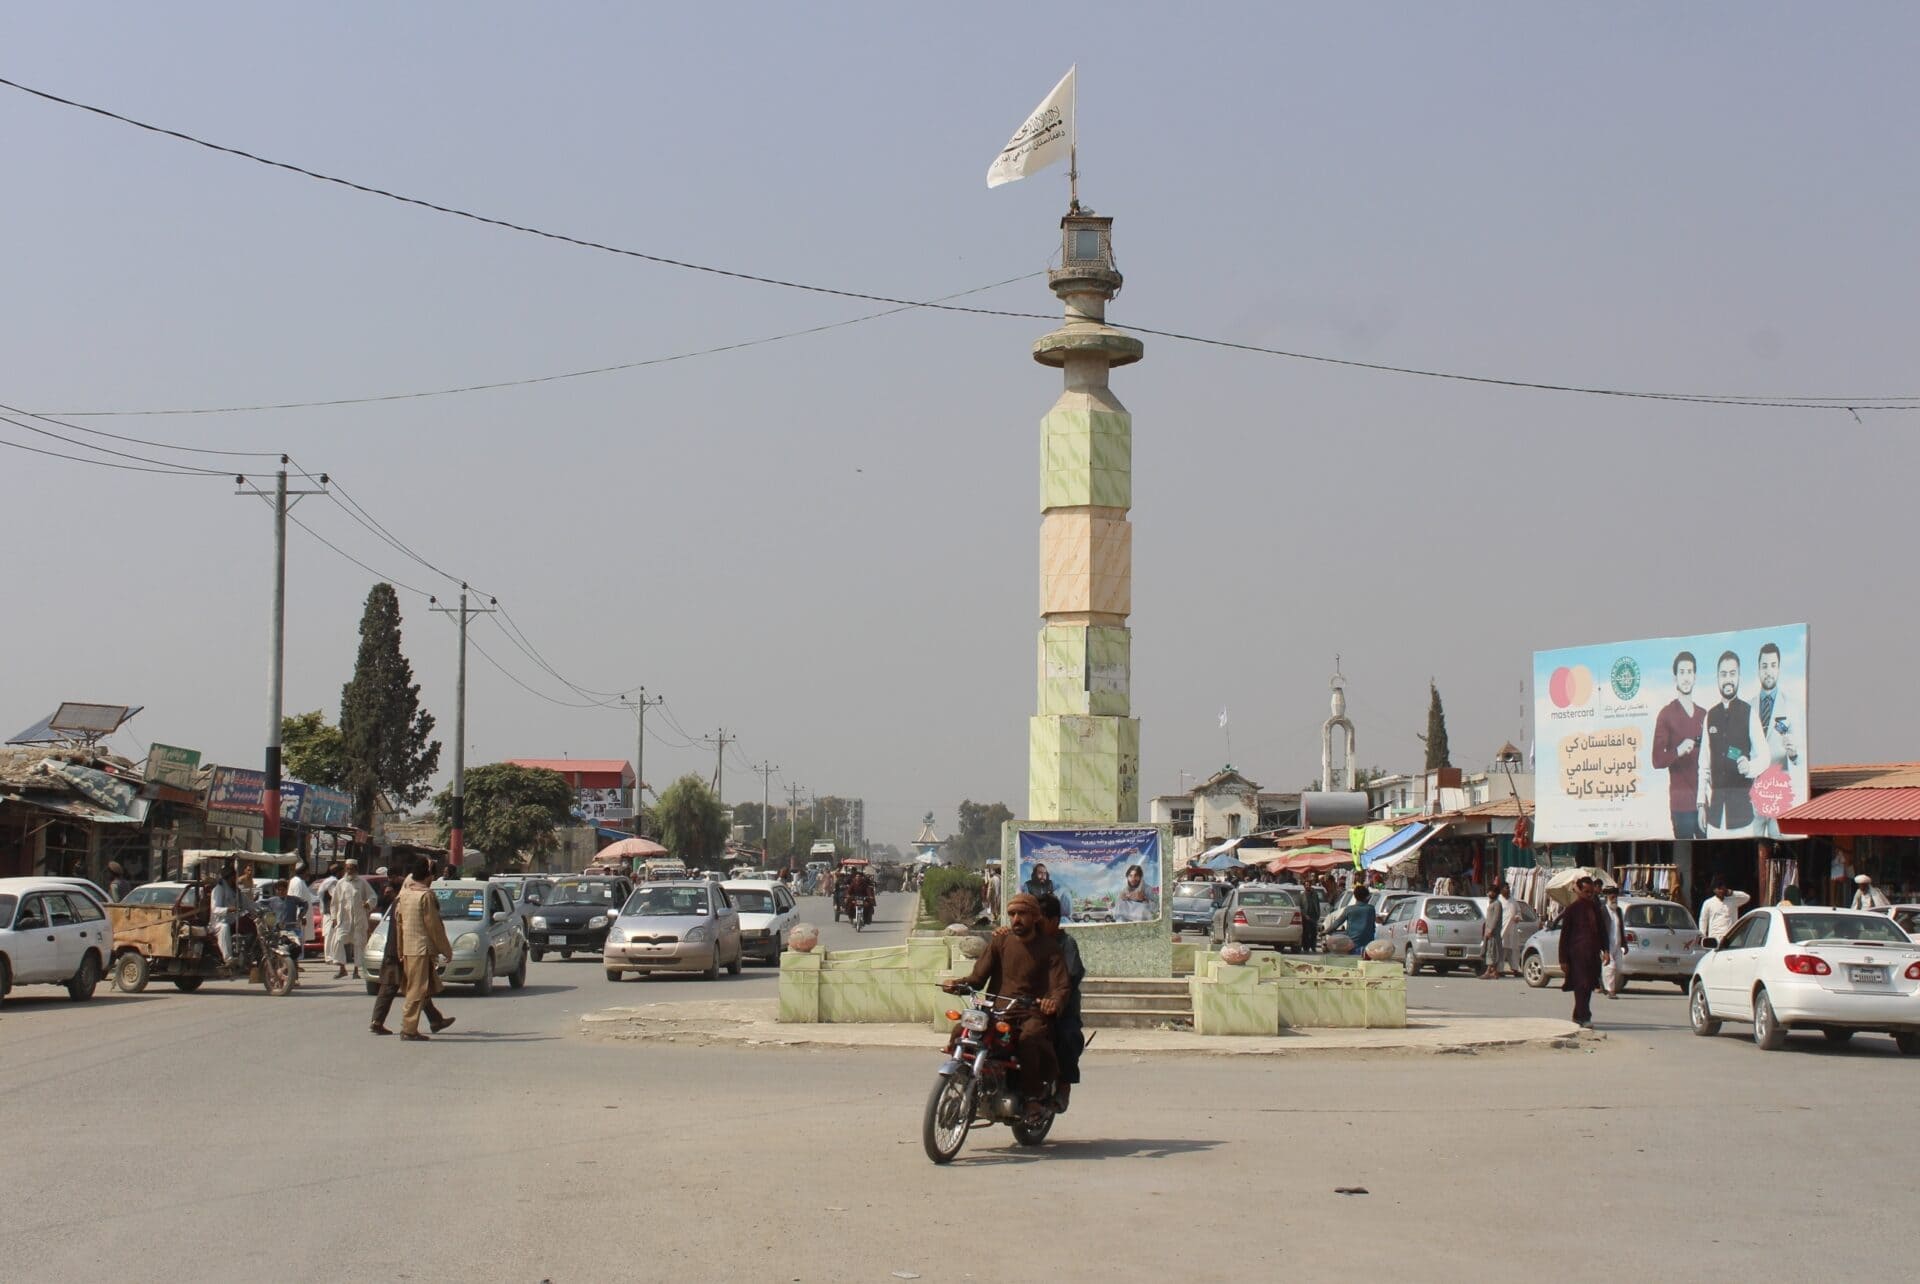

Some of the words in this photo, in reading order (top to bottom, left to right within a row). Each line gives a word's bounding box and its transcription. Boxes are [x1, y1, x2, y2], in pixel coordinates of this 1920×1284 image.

[1551, 708, 1594, 720] mastercard
[1580, 733, 1625, 750] افغانستان
[1627, 736, 1637, 752] په
[1566, 779, 1593, 799] کارت
